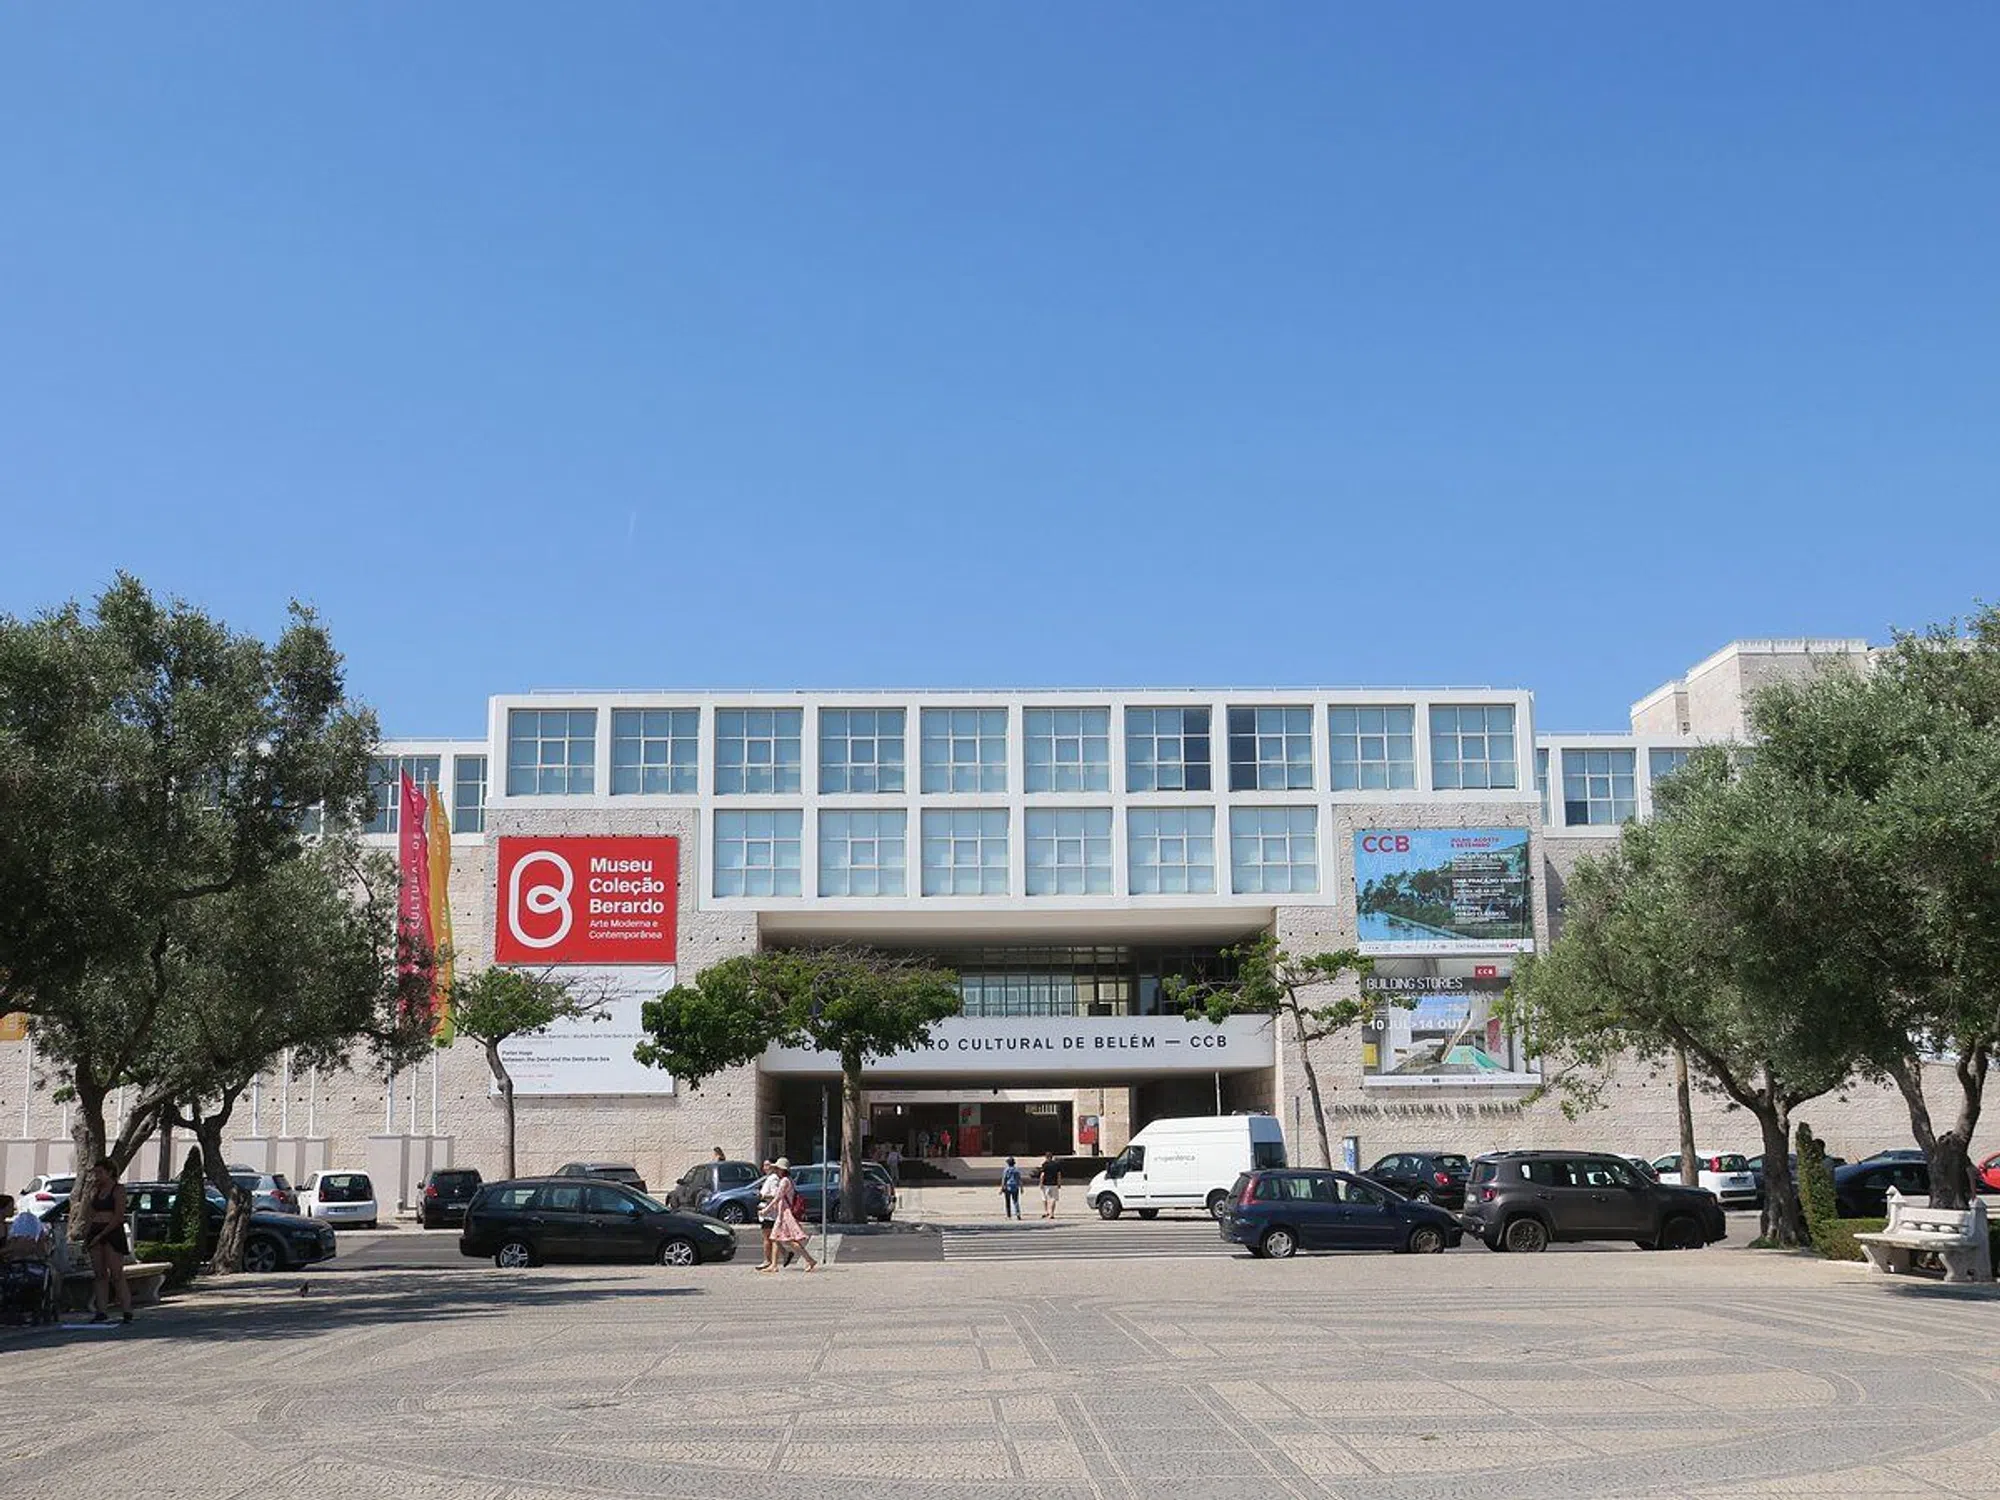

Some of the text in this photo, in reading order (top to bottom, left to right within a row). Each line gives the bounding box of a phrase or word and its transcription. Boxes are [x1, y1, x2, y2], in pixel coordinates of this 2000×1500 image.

[1362, 835, 1410, 853] CCB
[590, 858, 653, 873] Museu
[589, 876, 665, 896] Coleção
[590, 898, 665, 914] Berardo
[589, 919, 609, 928] Arte
[610, 919, 651, 928] Moderna
[588, 930, 663, 940] Contemporânea
[1366, 977, 1463, 990] BUILDING STORIES
[1370, 1020, 1385, 1030] 10
[1420, 1020, 1433, 1029] 14
[958, 1036, 1054, 1051] CULTURAL
[1063, 1036, 1085, 1050] DE
[1094, 1033, 1156, 1049] BELÉM
[1190, 1035, 1228, 1048] CCB
[1324, 1103, 1378, 1116] CENTRO
[1383, 1103, 1450, 1116] CULTURAL
[1456, 1103, 1473, 1115] DE
